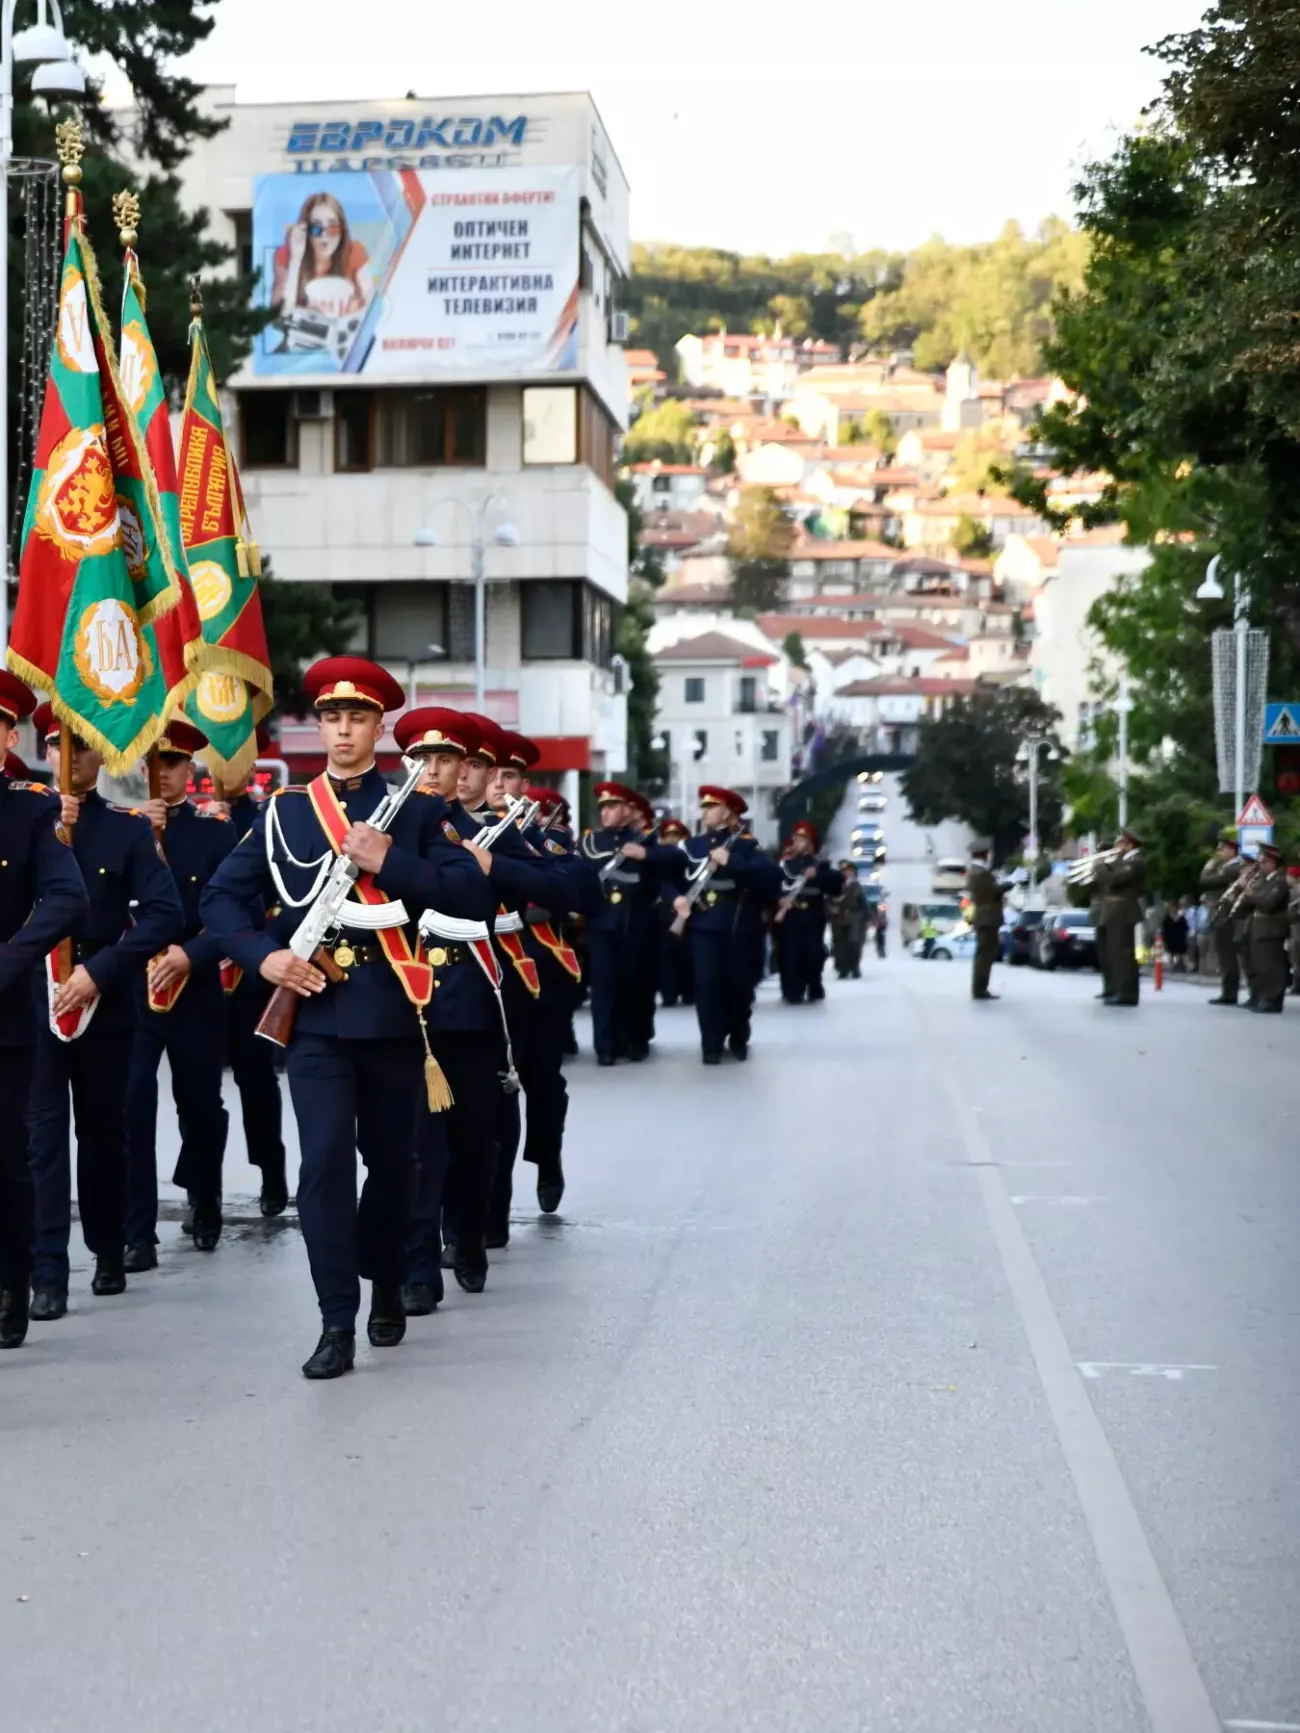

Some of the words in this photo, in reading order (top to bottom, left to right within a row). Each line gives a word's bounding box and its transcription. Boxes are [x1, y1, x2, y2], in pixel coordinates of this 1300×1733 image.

[286, 116, 528, 154] ЕВРОКОМ
[453, 220, 528, 238] ОПТИЧЕН
[450, 242, 531, 261] ИНТЕРНЕТ
[427, 274, 554, 294] ИНТЕРАКТИВНА
[443, 297, 538, 316] ТЕЛЕВИЗИЯ
[179, 425, 209, 520] РЕПУБЛИКА
[201, 444, 227, 533] БЪЛГАРИЯ
